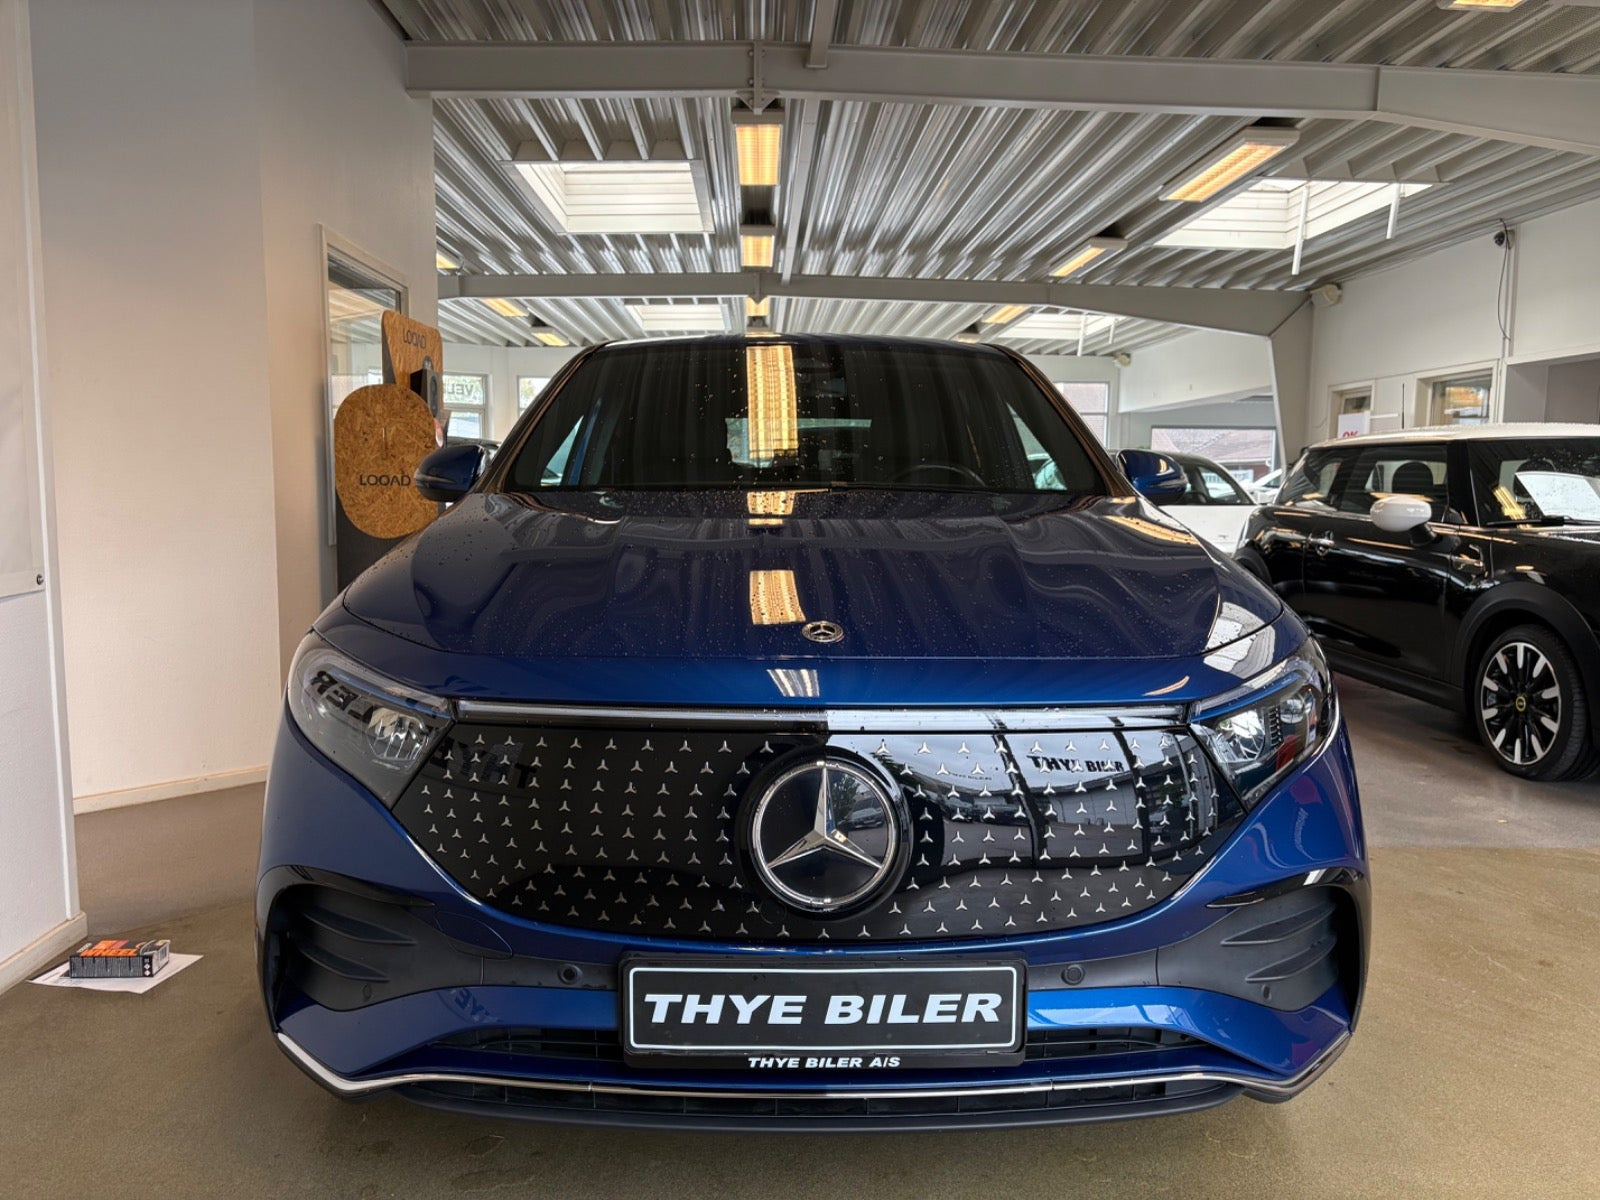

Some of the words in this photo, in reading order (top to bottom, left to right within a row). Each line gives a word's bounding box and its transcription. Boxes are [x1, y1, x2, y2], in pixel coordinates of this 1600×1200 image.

[360, 474, 411, 486] LOOAD
[644, 993, 807, 1025] THYE
[824, 993, 1002, 1025] BILER
[748, 1057, 800, 1069] THYE
[805, 1057, 863, 1069] BILER
[869, 1056, 901, 1068] A/S
